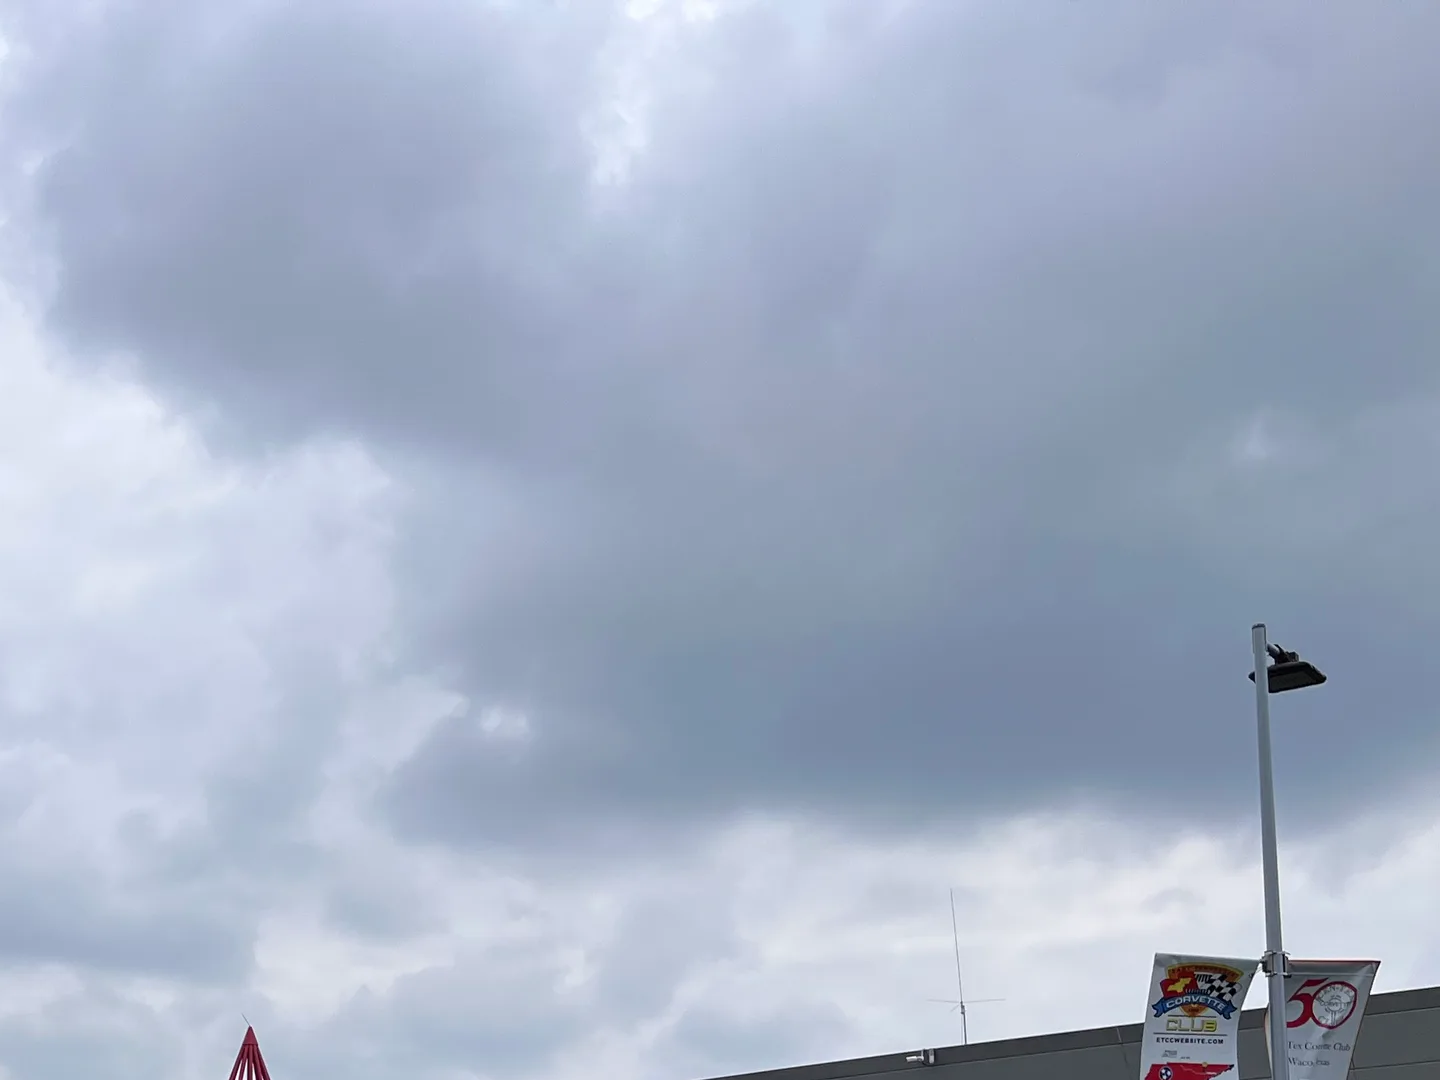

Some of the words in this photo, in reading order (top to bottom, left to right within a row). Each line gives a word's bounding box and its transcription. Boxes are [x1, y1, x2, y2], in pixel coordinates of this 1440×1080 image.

[1167, 996, 1226, 1011] CORVETTE
[1166, 1018, 1217, 1032] CLUB
[1156, 1037, 1224, 1045] ETCCWEBSITE.COM
[1333, 1042, 1351, 1052] Club
